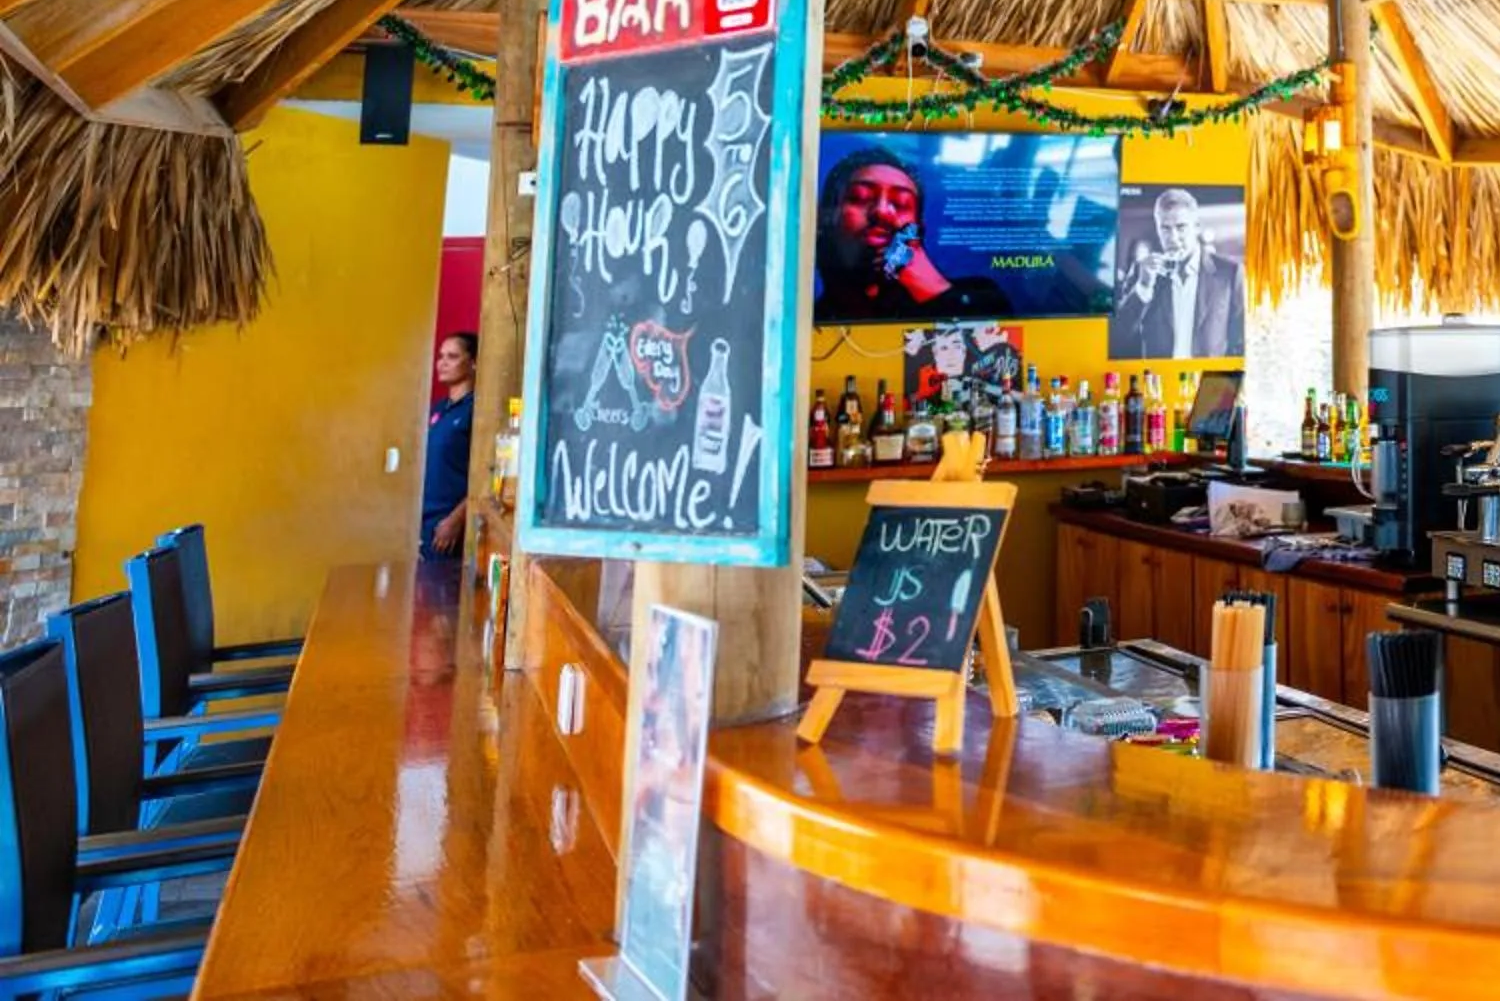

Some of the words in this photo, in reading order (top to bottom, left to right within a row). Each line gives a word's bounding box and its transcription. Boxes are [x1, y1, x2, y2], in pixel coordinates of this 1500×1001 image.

[574, 76, 697, 204] Happy
[716, 63, 753, 140] 5
[719, 172, 748, 237] 6
